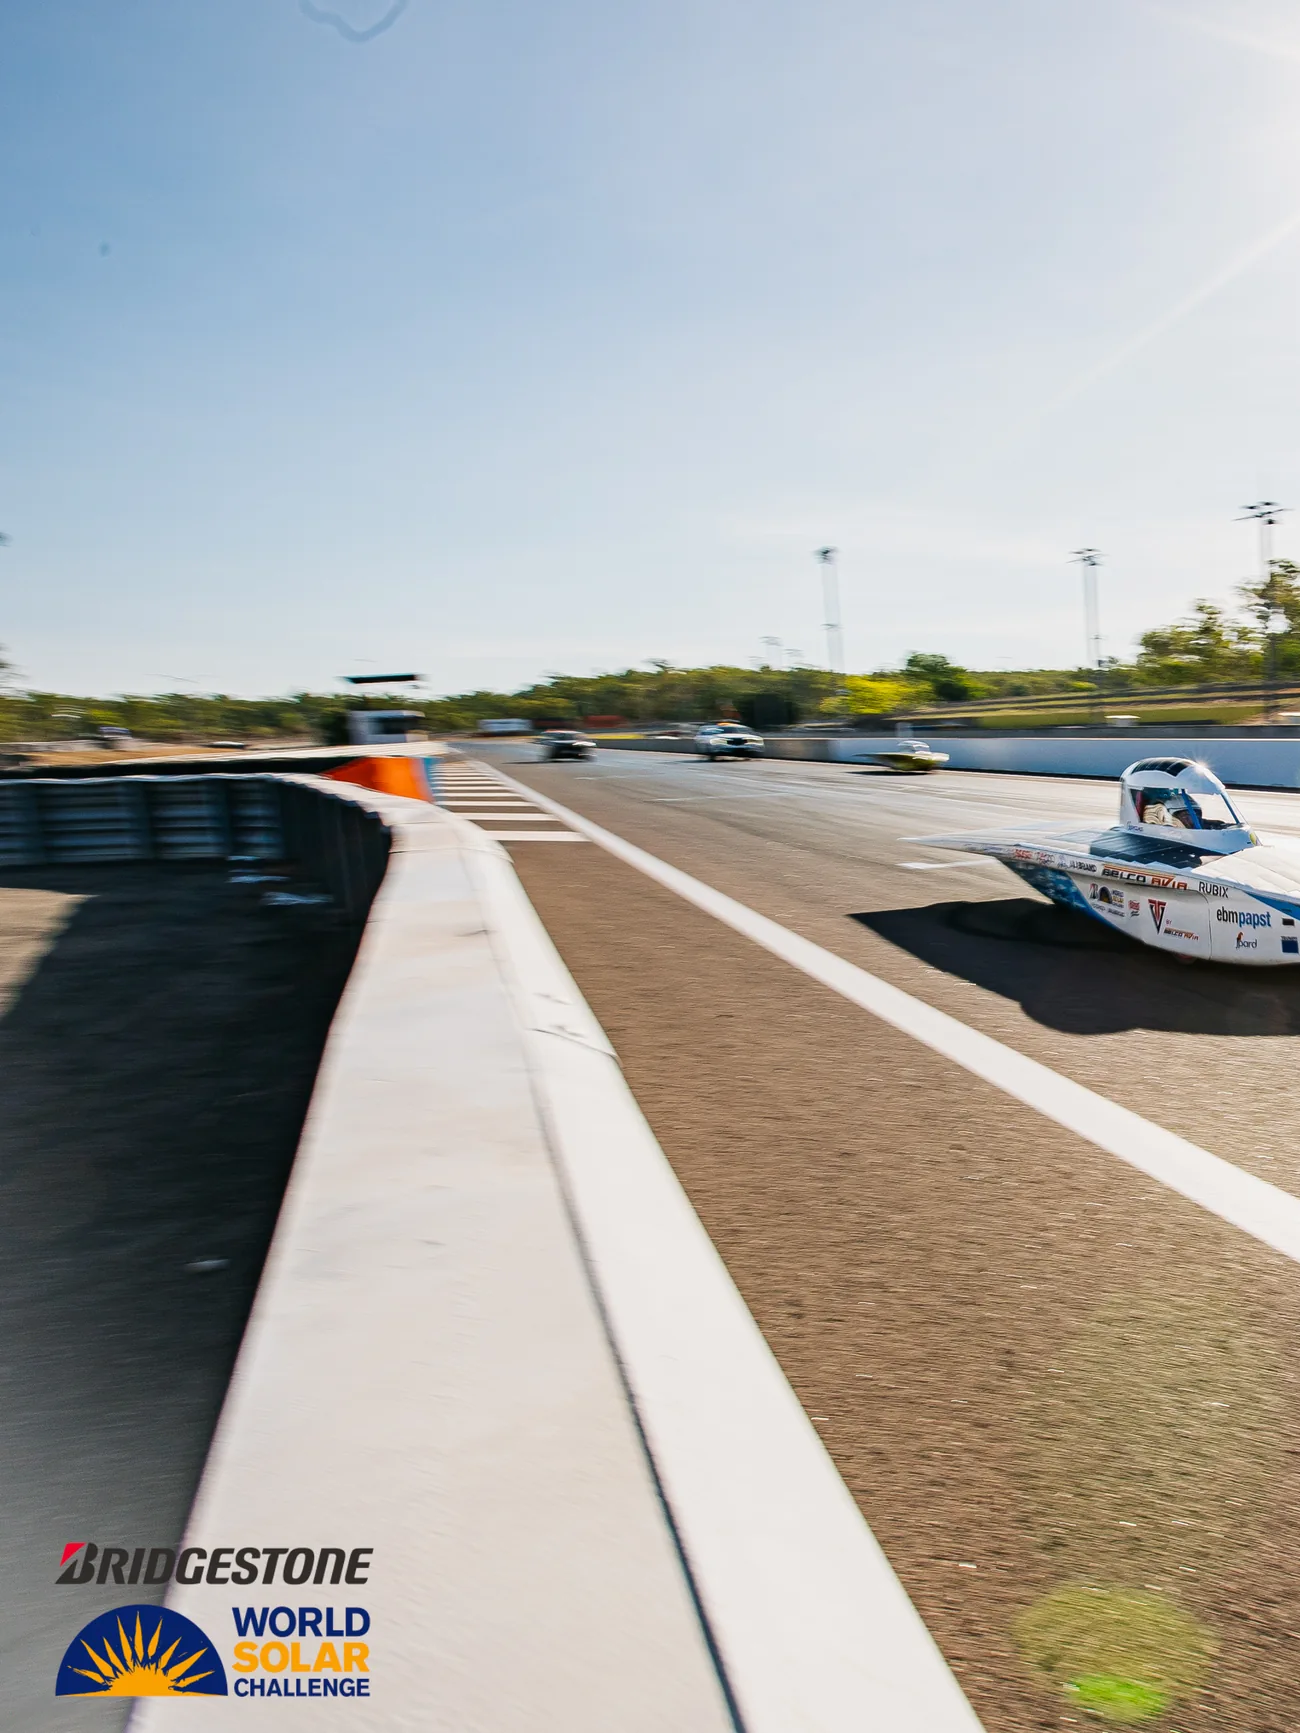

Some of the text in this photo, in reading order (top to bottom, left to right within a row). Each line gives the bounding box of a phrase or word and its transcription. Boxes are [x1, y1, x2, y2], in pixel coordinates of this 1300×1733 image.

[1102, 868, 1188, 890] BELCO AVIA
[1199, 882, 1229, 898] RUBIX
[1216, 906, 1272, 929] ebmpapst
